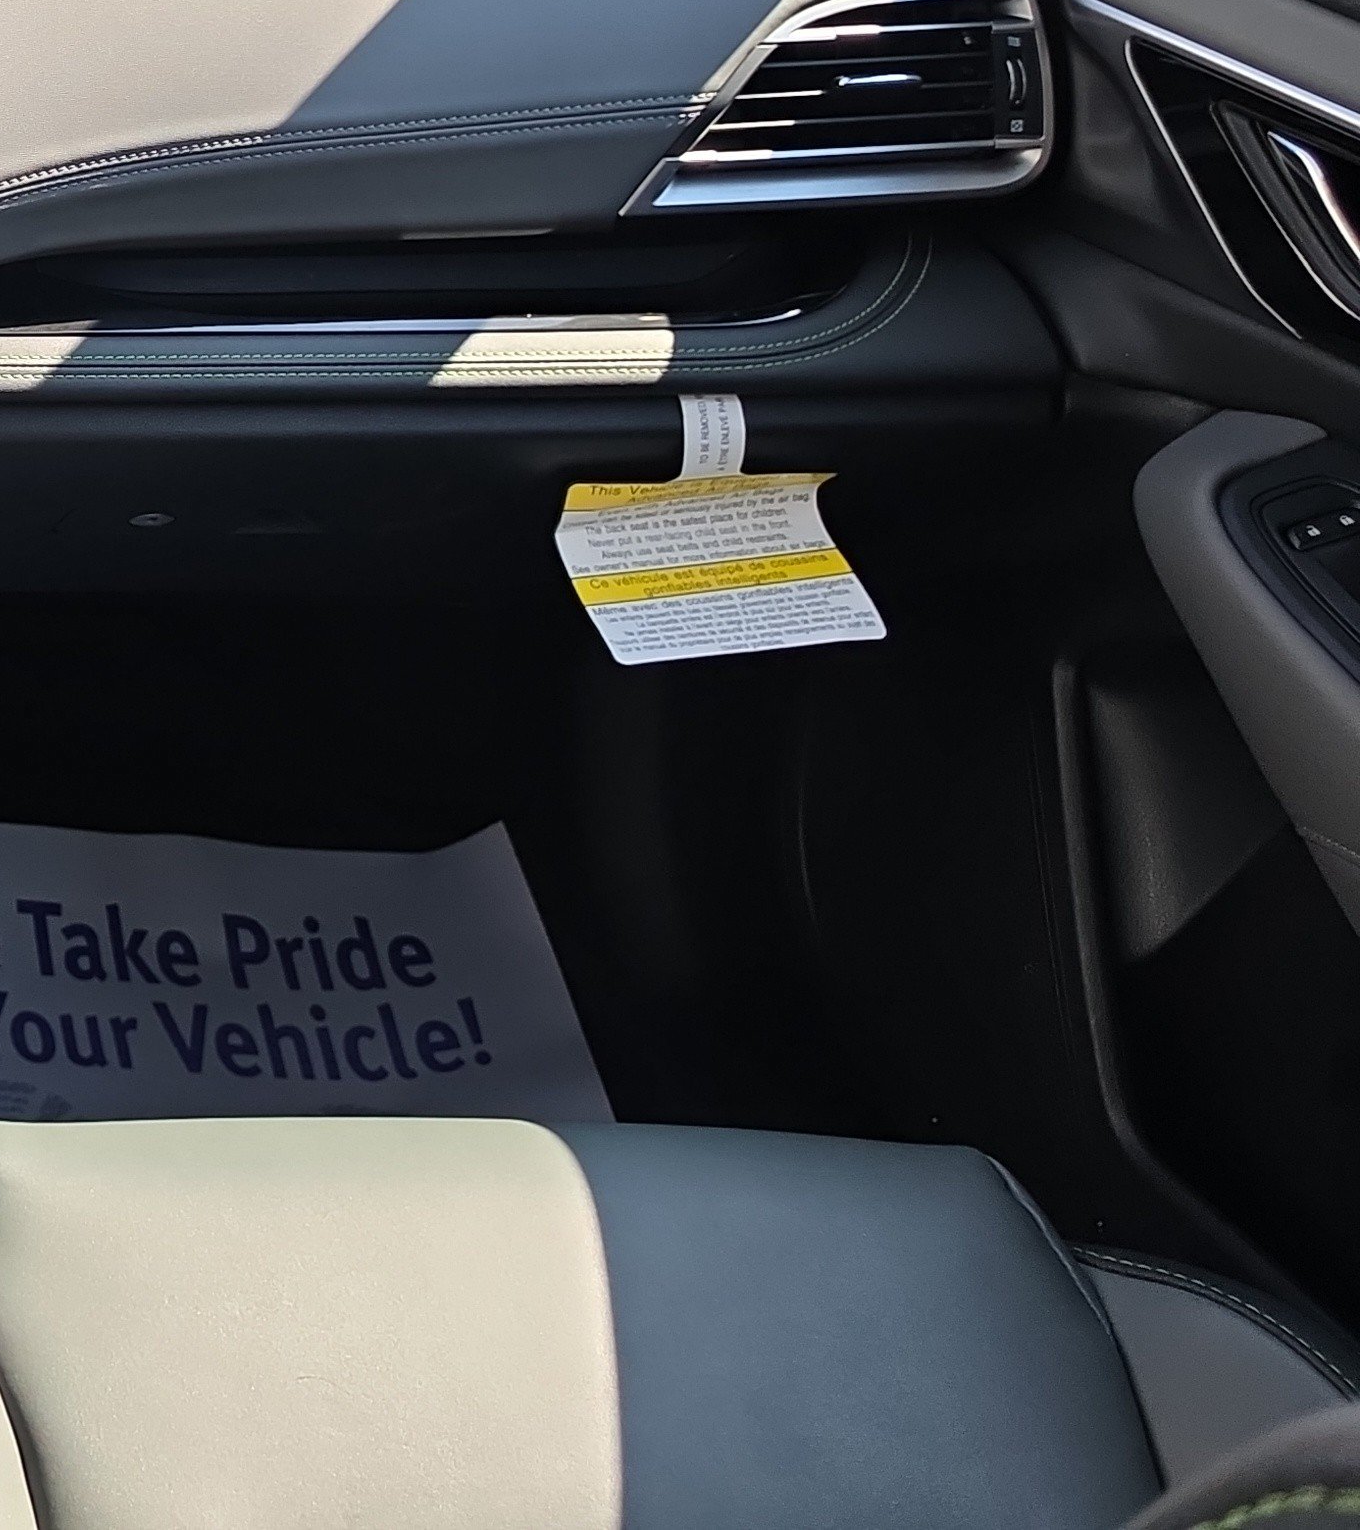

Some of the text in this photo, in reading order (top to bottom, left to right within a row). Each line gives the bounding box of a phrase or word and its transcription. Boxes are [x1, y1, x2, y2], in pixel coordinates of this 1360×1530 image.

[589, 484, 622, 497] This
[589, 578, 610, 590] Ce
[613, 571, 669, 587] véhicule
[674, 569, 694, 580] est
[748, 560, 766, 571] de
[770, 554, 829, 569] coussins
[15, 897, 203, 989] Take
[222, 912, 438, 993] Pride
